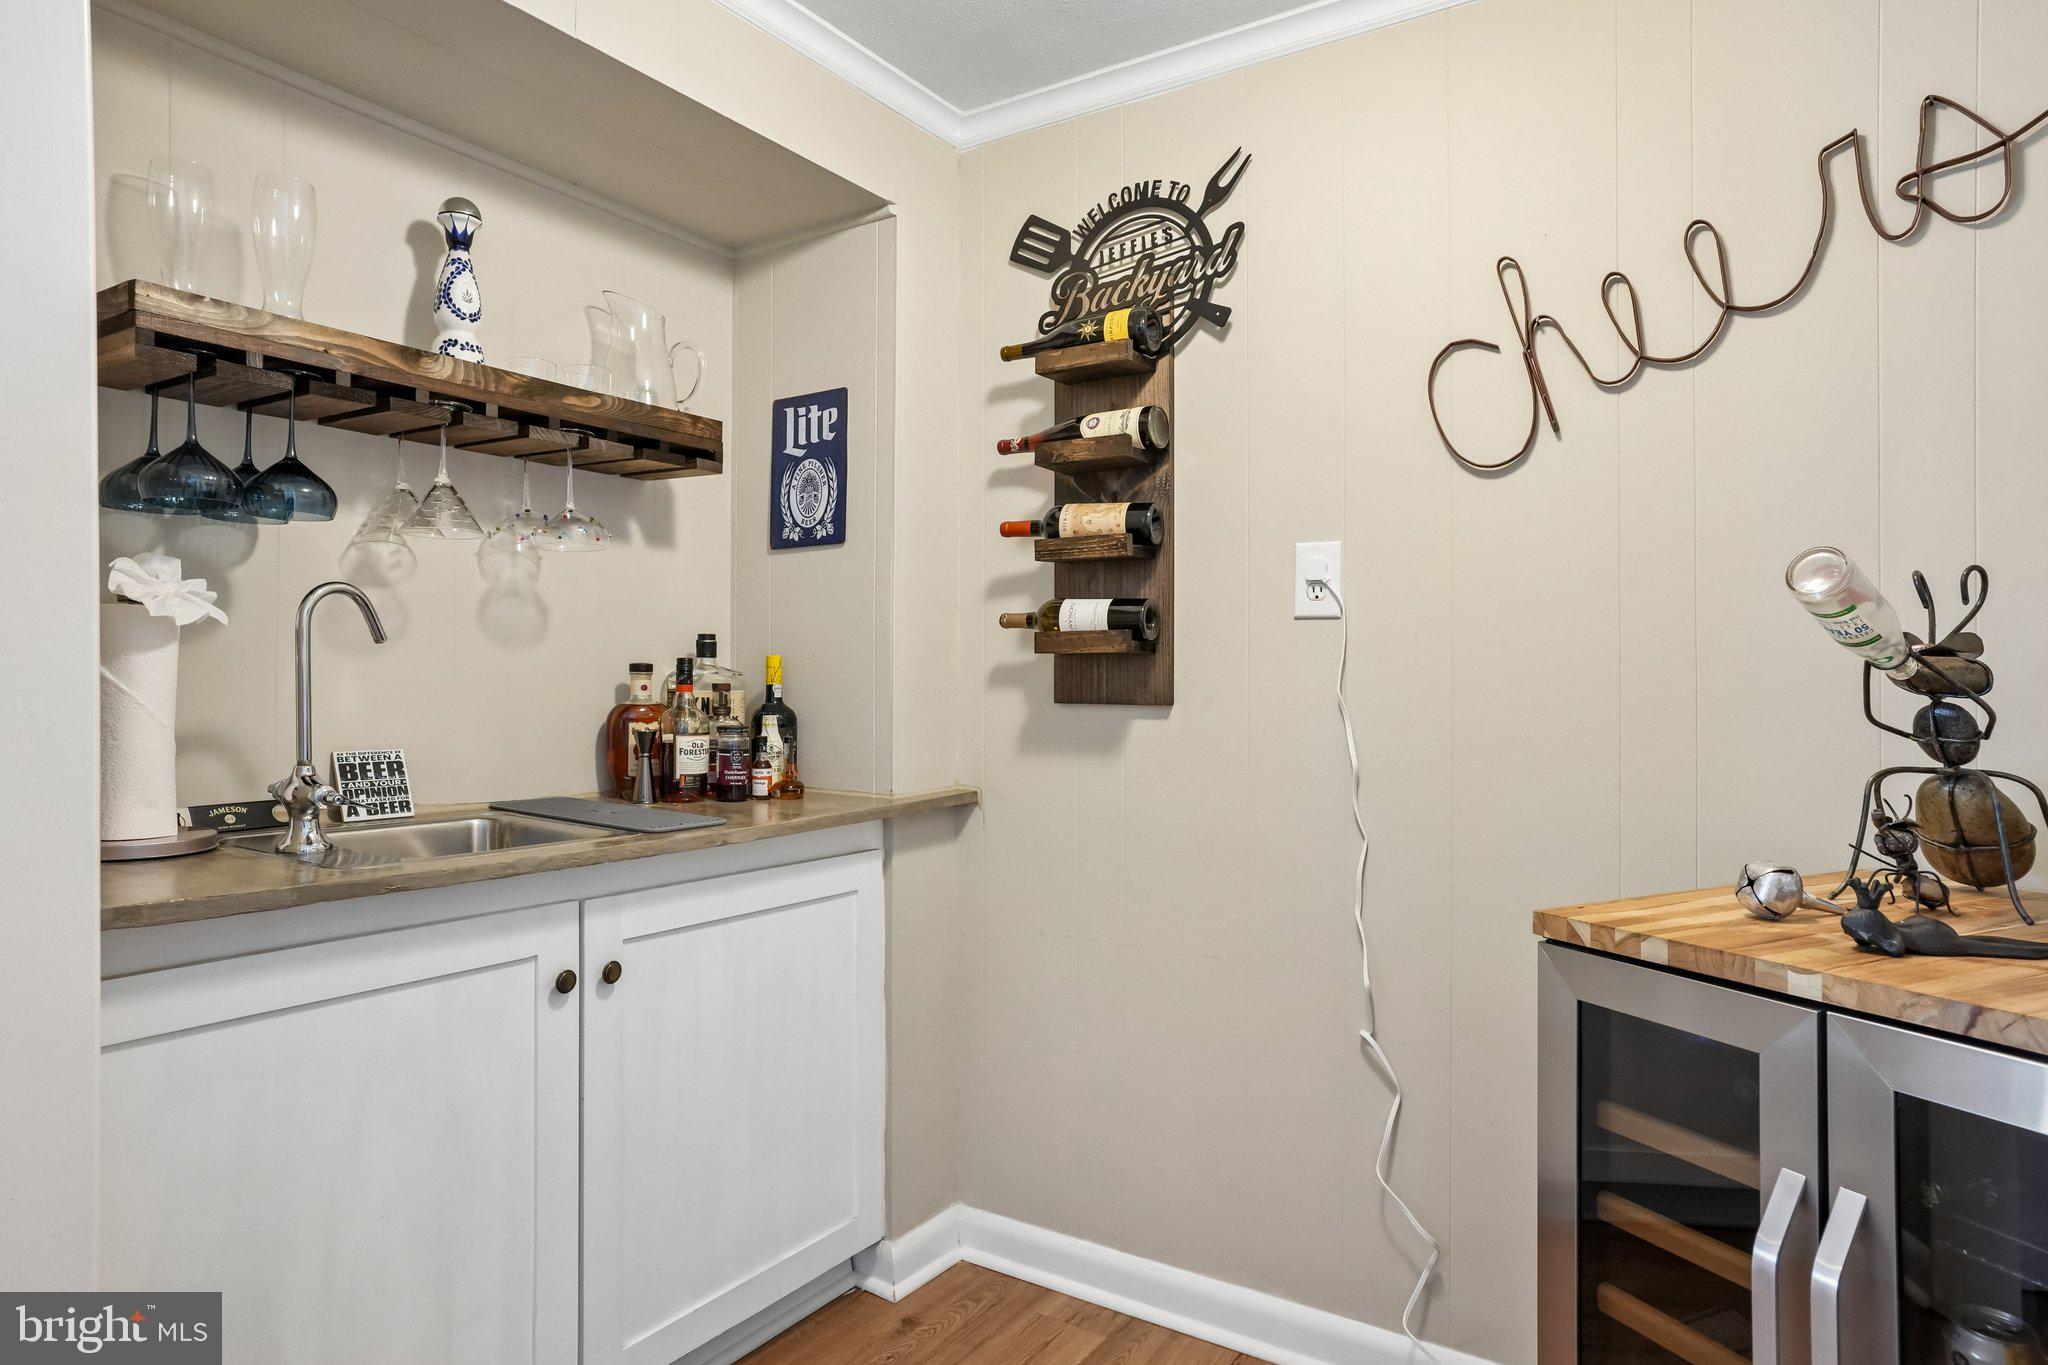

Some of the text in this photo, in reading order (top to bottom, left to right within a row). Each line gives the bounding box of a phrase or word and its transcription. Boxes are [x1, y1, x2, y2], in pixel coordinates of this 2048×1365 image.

[1073, 180, 1191, 238] WELCOME TO
[1039, 222, 1245, 336] Backyard
[1428, 95, 2048, 470] cheers
[783, 405, 839, 458] Lite
[794, 463, 806, 481] FINE
[808, 461, 827, 486] PILSNER
[801, 516, 817, 526] BEER
[1067, 602, 1077, 631] AYSON
[1854, 623, 1870, 634] 50
[691, 741, 704, 749] OLD
[336, 755, 391, 763] BETWEEN
[337, 760, 406, 782] BEER
[342, 785, 409, 800] OPINION
[348, 779, 402, 789] AND YOUR
[208, 805, 248, 817] JAMESON
[346, 800, 412, 818] A BEER
